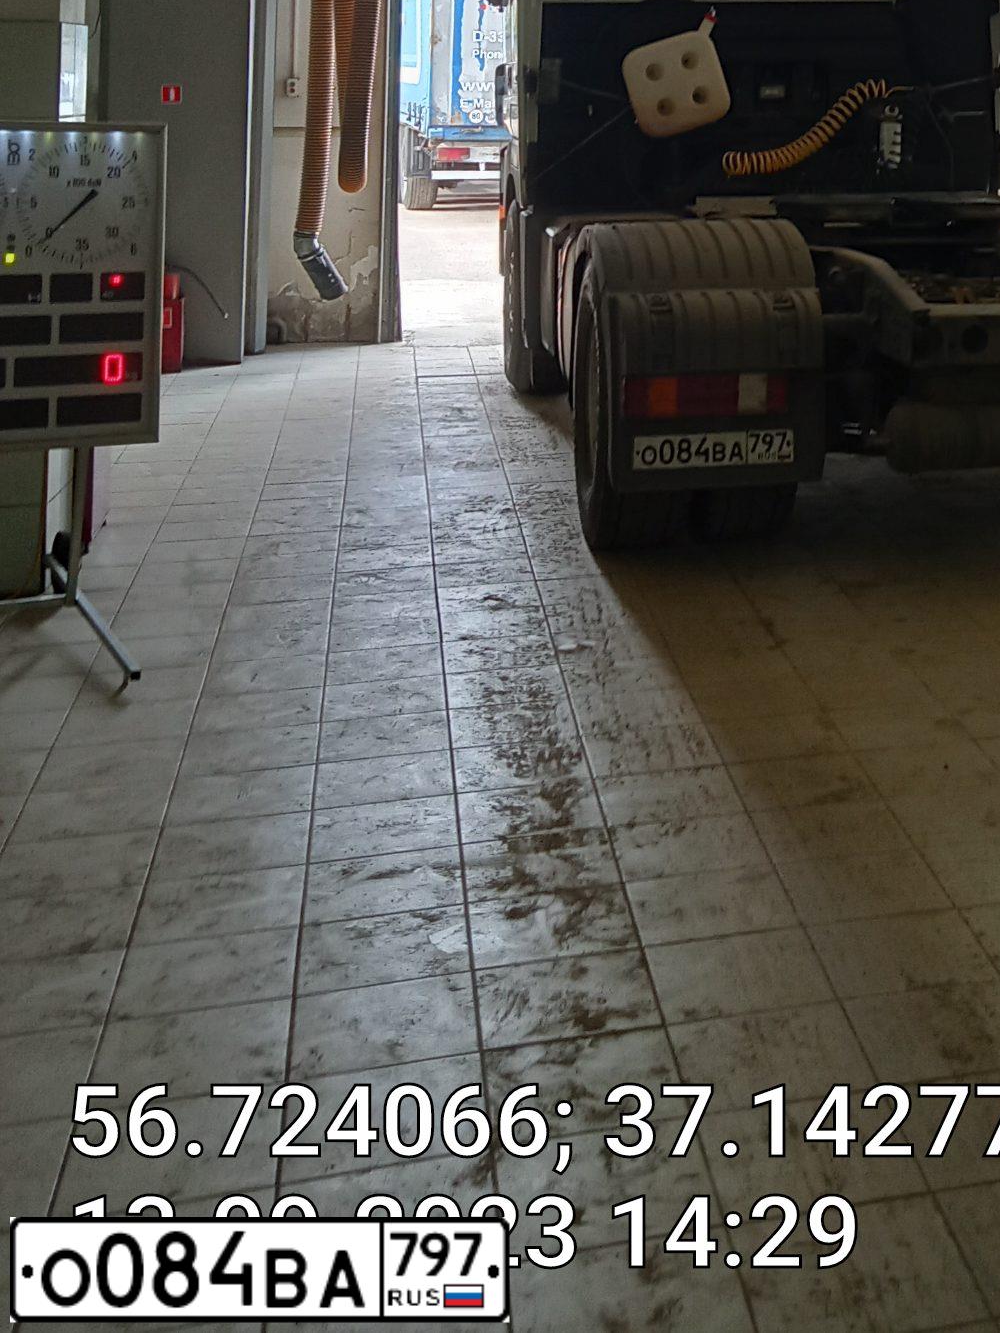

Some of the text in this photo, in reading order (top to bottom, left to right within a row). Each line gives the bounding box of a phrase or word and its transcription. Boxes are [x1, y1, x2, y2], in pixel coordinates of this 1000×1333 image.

[28, 148, 36, 161] 2
[79, 155, 91, 167] 15
[48, 166, 60, 178] 10
[107, 166, 121, 178] 20
[121, 197, 136, 209] 25
[105, 226, 119, 238] 30
[25, 244, 33, 257] 0
[75, 238, 90, 251] 35
[104, 353, 124, 382] 0
[748, 431, 788, 454] 797
[641, 436, 744, 466] О084ВА
